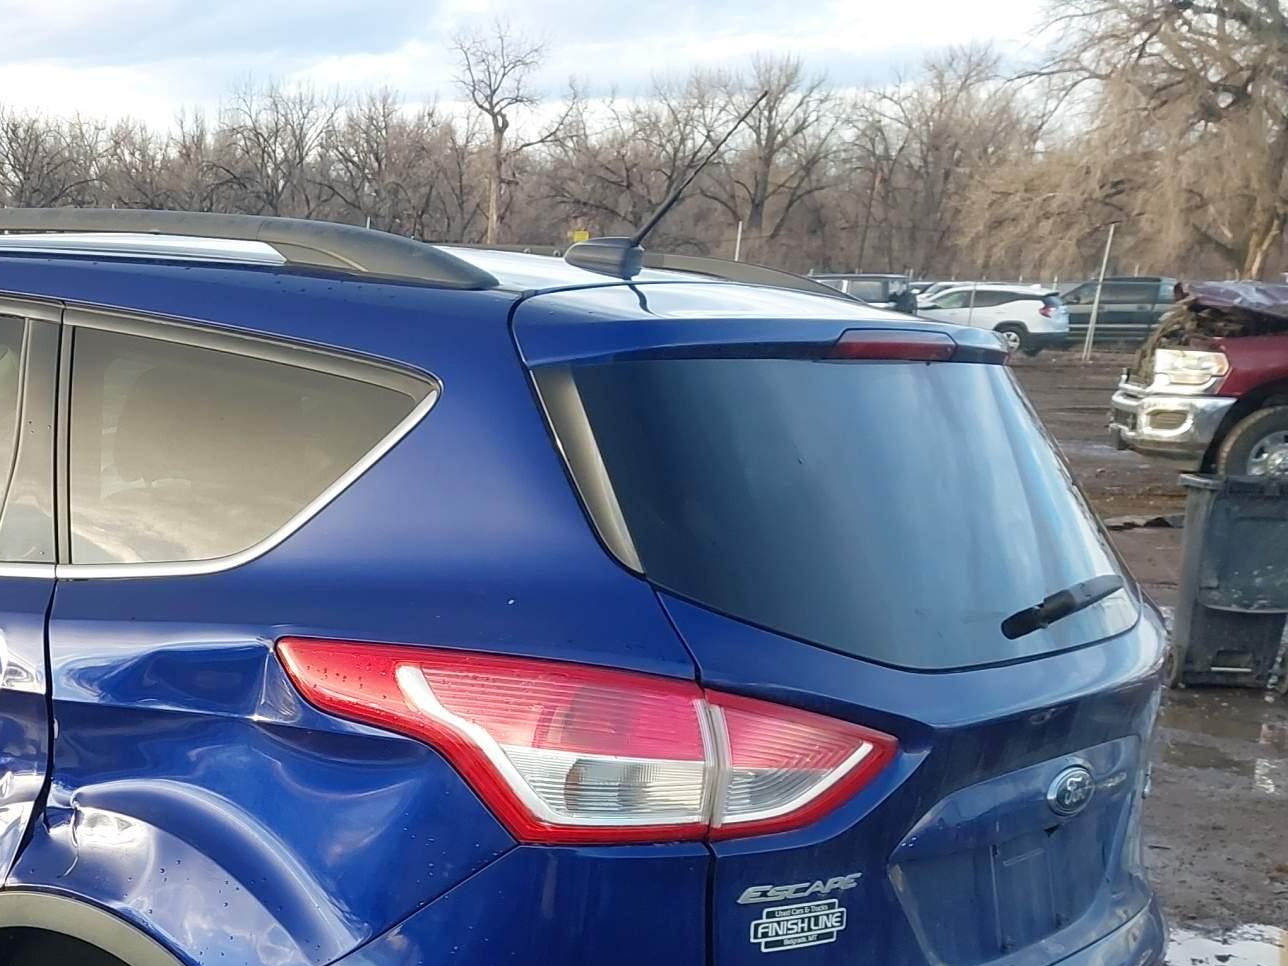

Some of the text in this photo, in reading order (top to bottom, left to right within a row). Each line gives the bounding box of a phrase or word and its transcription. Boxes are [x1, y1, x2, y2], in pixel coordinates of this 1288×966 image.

[737, 872, 863, 904] ESCAPE
[758, 912, 842, 938] FINISH LINE
[791, 908, 804, 916] Cars
